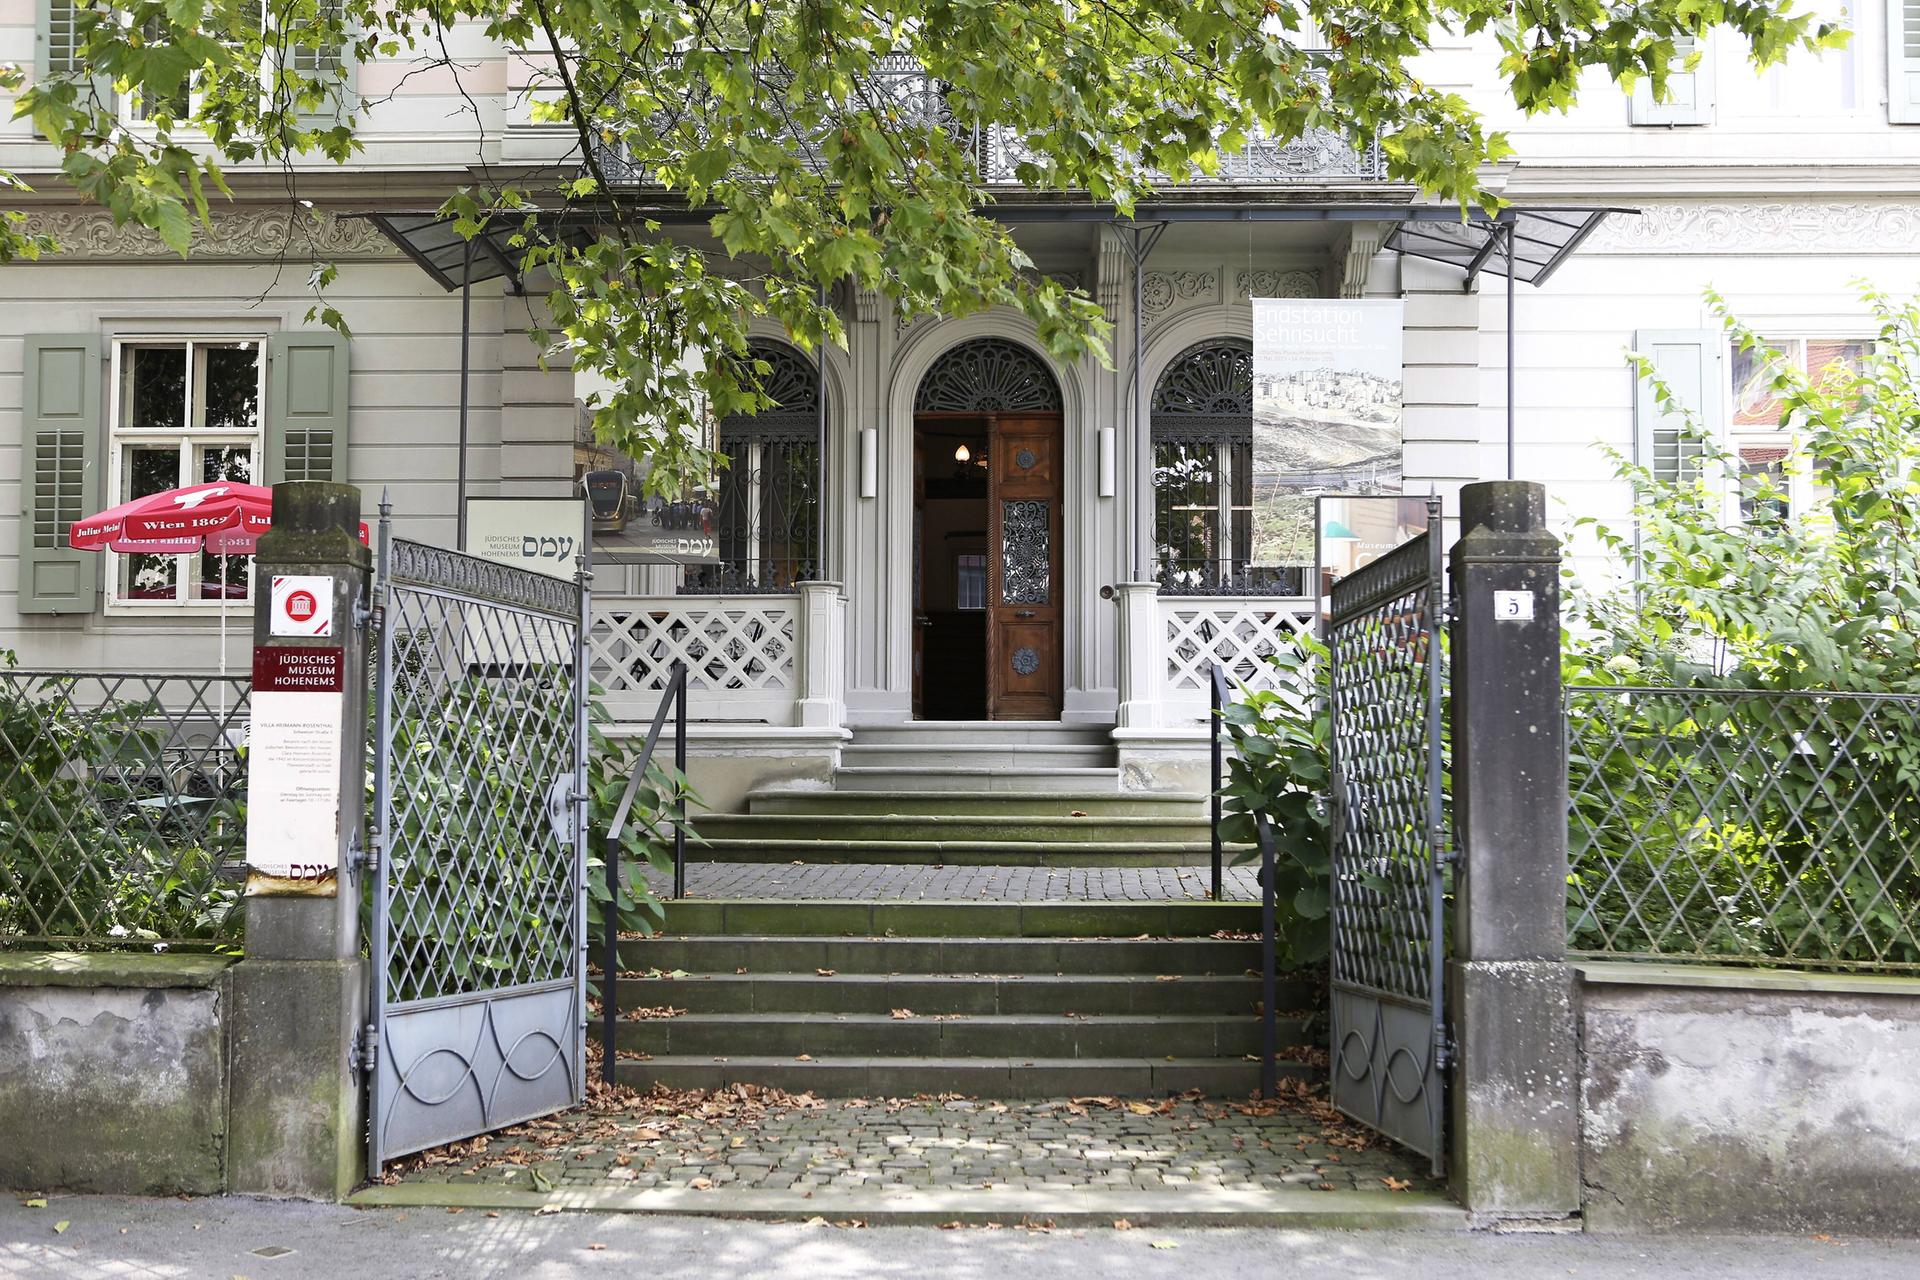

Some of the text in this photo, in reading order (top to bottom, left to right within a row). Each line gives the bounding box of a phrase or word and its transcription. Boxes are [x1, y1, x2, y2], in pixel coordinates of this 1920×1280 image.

[1255, 305, 1363, 324] Endstation
[1255, 323, 1359, 343] Sehnsucht
[249, 515, 272, 525] Jul
[143, 521, 185, 530] Wien
[76, 526, 101, 537] Julius
[484, 535, 520, 543] JÜDISCHES
[1509, 597, 1519, 615] 5
[279, 653, 336, 665] JÜDISCHES
[288, 666, 336, 675] MUSEUM
[274, 677, 335, 686] HOHENEMS
